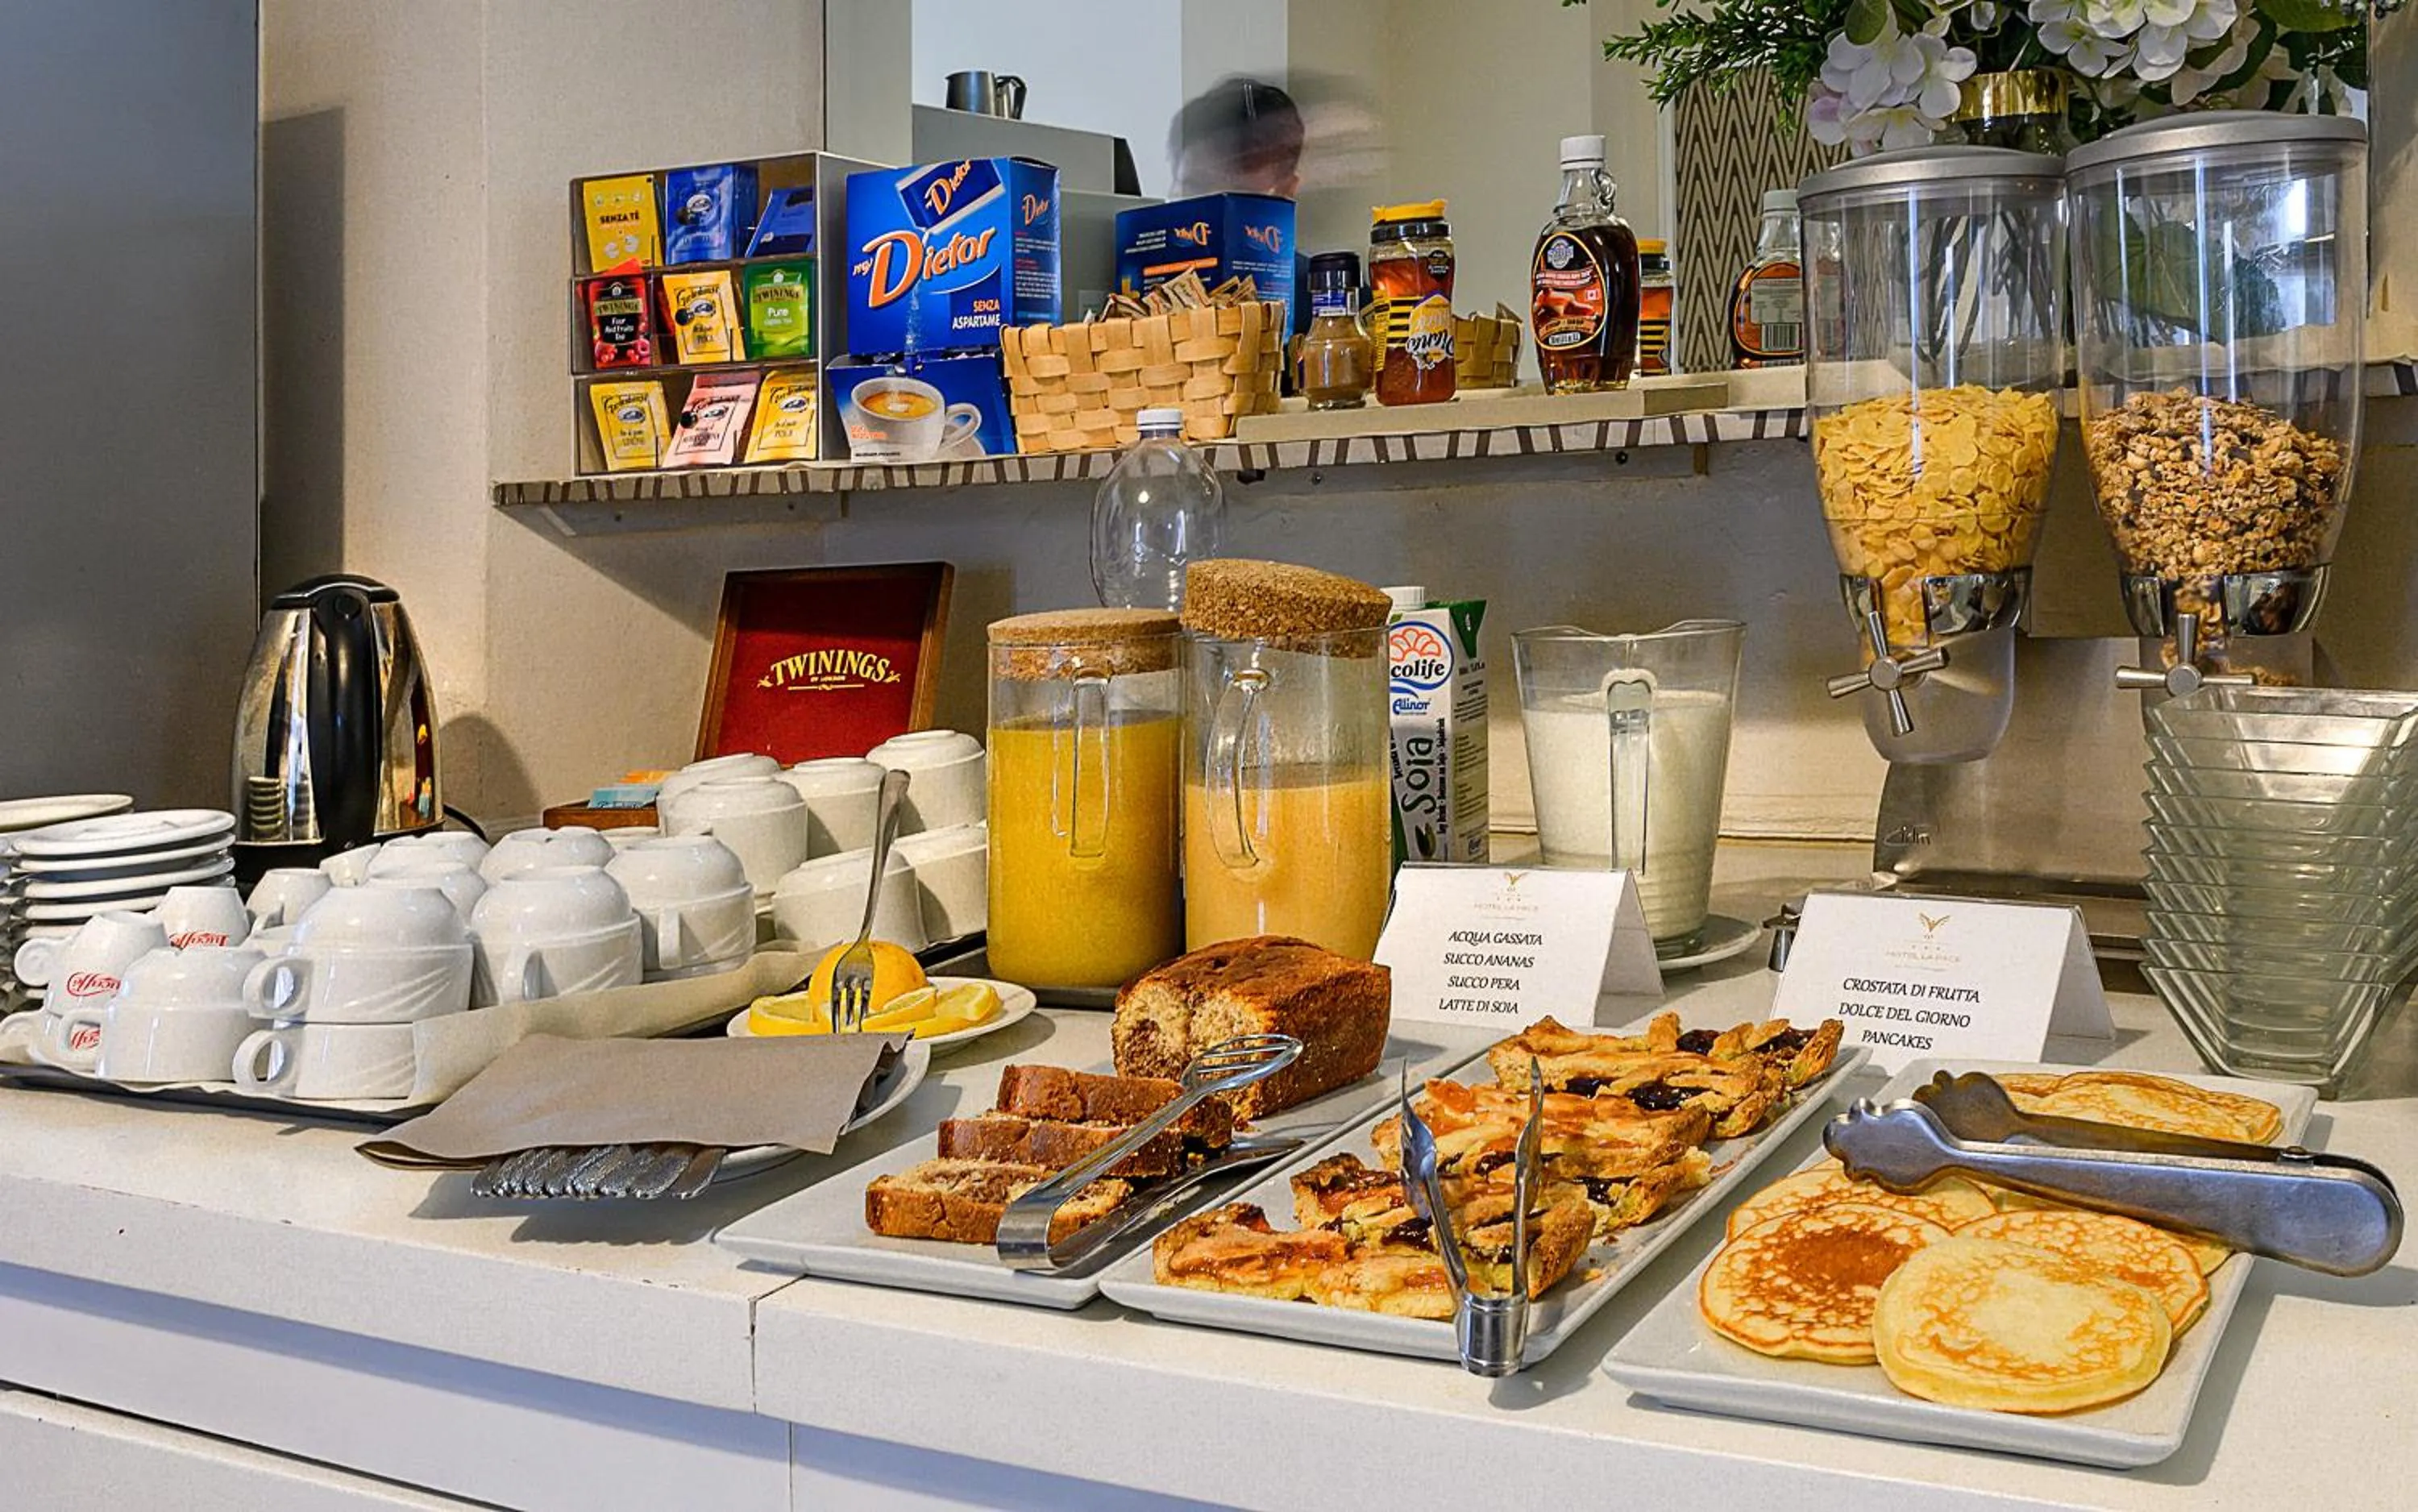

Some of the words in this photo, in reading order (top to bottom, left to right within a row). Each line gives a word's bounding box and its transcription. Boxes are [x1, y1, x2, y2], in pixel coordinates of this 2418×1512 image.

[600, 214, 628, 224] SENZA
[862, 230, 996, 308] Dietor
[755, 286, 800, 303] TWININGS
[596, 298, 639, 314] TWININGS
[767, 306, 788, 318] Pure
[973, 299, 1000, 313] SENZA
[952, 314, 1001, 330] ASPARTAME
[771, 649, 890, 685] TWININGS
[1391, 658, 1445, 679] colife
[1393, 697, 1430, 716] Alinor
[1401, 737, 1437, 815] Soia
[1448, 931, 1490, 946] ACQUA
[1493, 933, 1543, 945] GASSATA
[1444, 952, 1484, 966] SUCCO
[1485, 955, 1535, 968] ANANAS
[1448, 976, 1489, 989] SUCCO
[1490, 978, 1520, 991] PERA
[1843, 978, 1907, 996] CROSTATA
[1910, 984, 1926, 998] DI
[1928, 986, 1980, 1003] FRUTTA
[1439, 998, 1476, 1011] LATTE
[1476, 1000, 1490, 1012] DI
[1490, 1001, 1519, 1014] SOIA
[1838, 1002, 1884, 1019] DOLCE
[1885, 1007, 1913, 1021] DEL
[1916, 1010, 1971, 1028] GIORNO
[1861, 1029, 1934, 1050] PANCAKES
